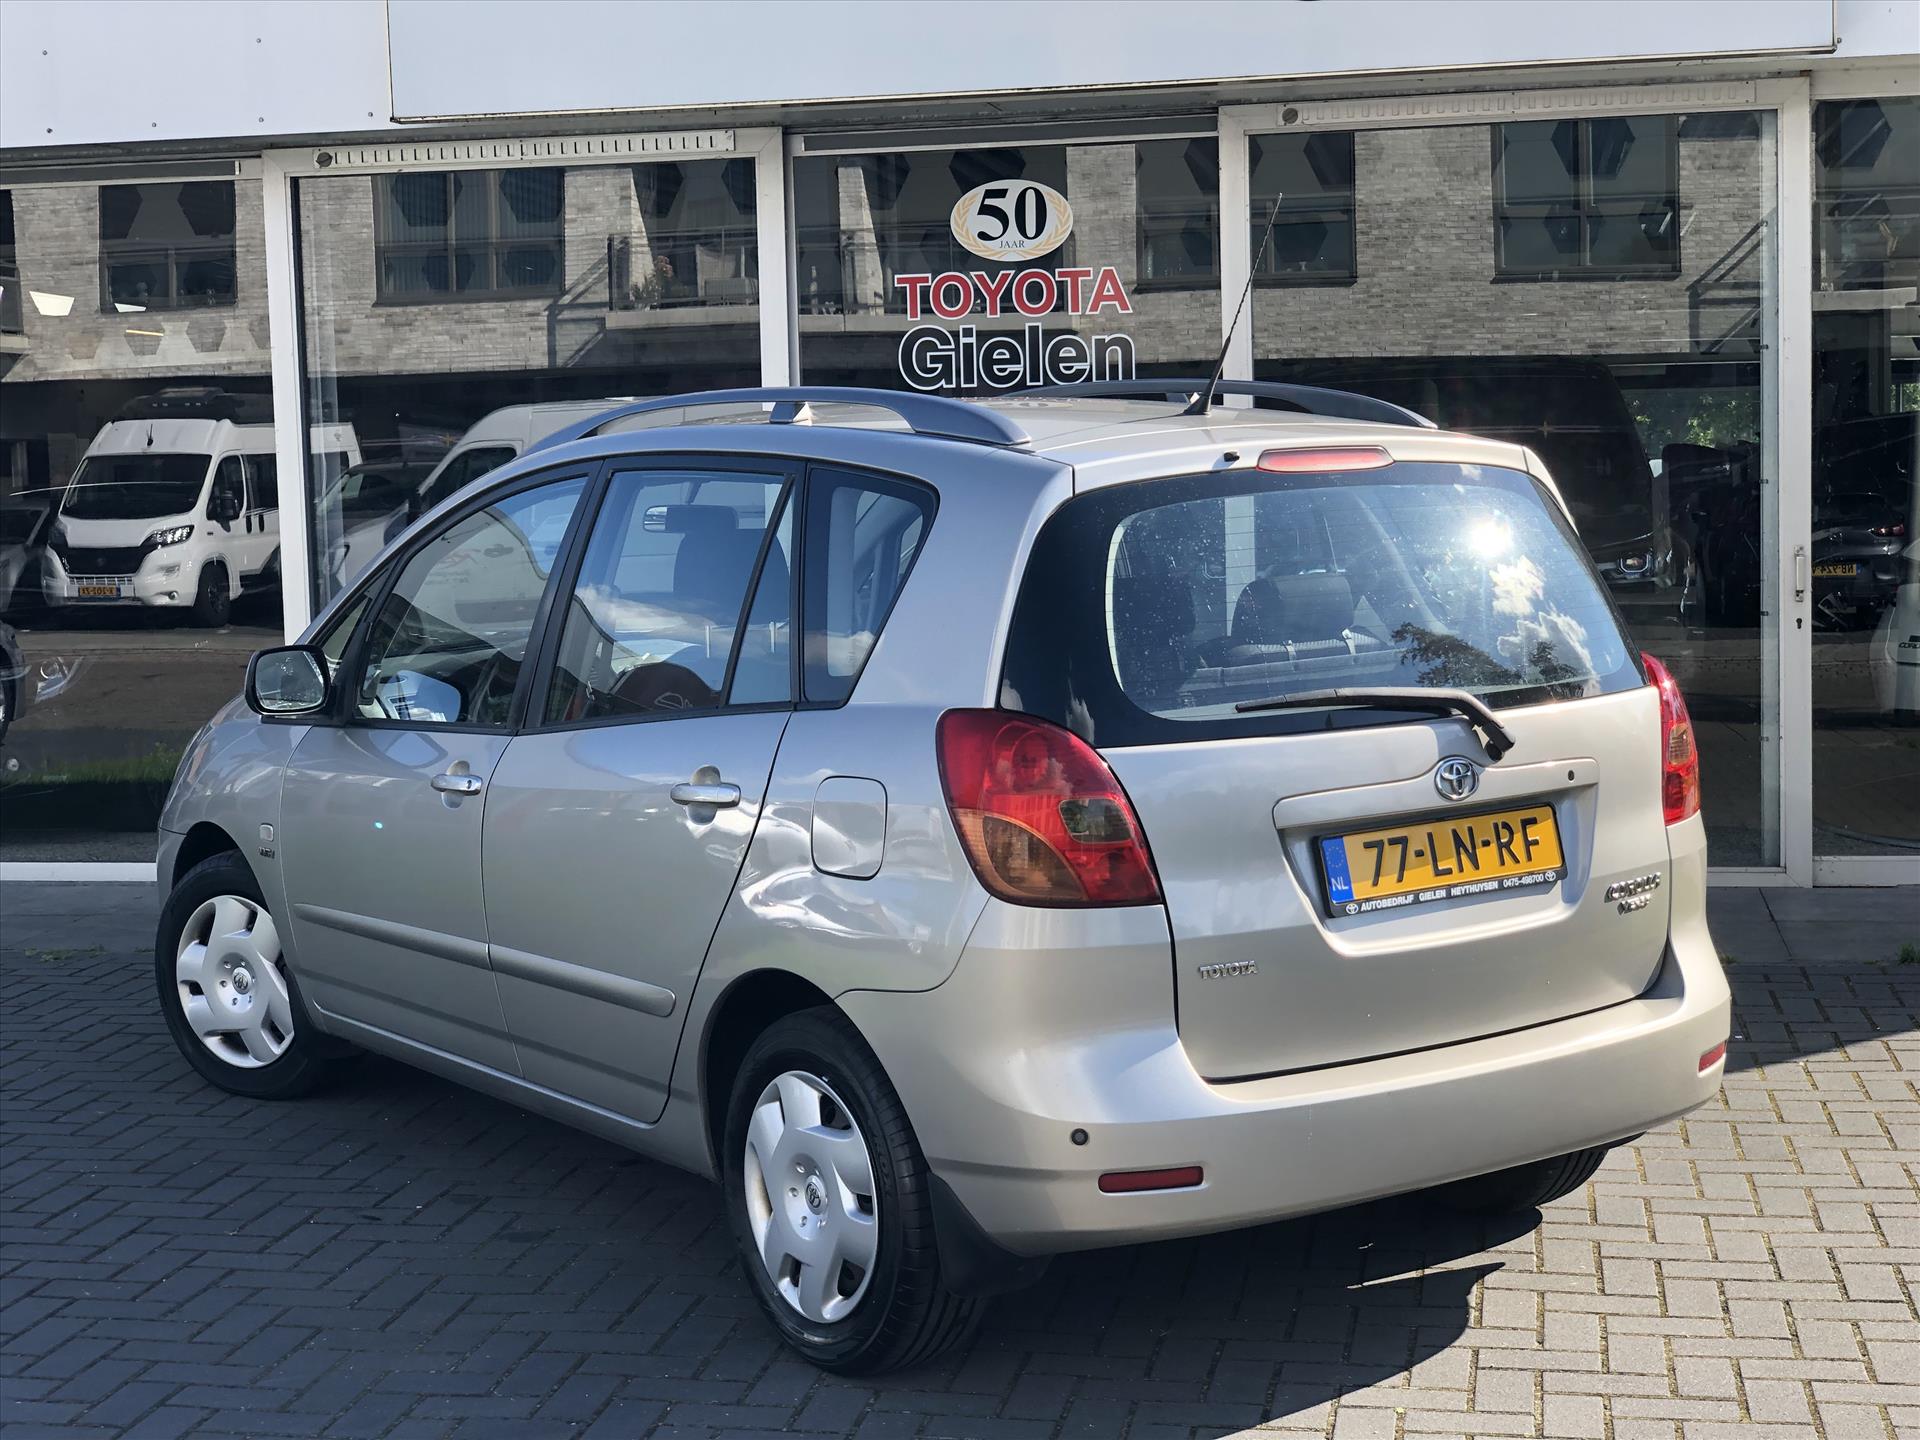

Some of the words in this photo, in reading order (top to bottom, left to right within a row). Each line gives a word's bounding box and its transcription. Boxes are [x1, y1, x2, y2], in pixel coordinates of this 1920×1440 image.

[977, 186, 1047, 241] 50
[1000, 239, 1025, 249] JAAR
[895, 267, 1133, 321] TOYOTA
[899, 322, 1136, 390] Gielen
[1363, 816, 1540, 887] 77-LN-RF
[1331, 876, 1349, 891] NL
[1360, 894, 1414, 912] AUTOBEDRIJF
[1419, 889, 1447, 901] GIELEN
[1450, 881, 1499, 897] HEYTHUYSEN
[1199, 960, 1257, 979] TOYOTA
